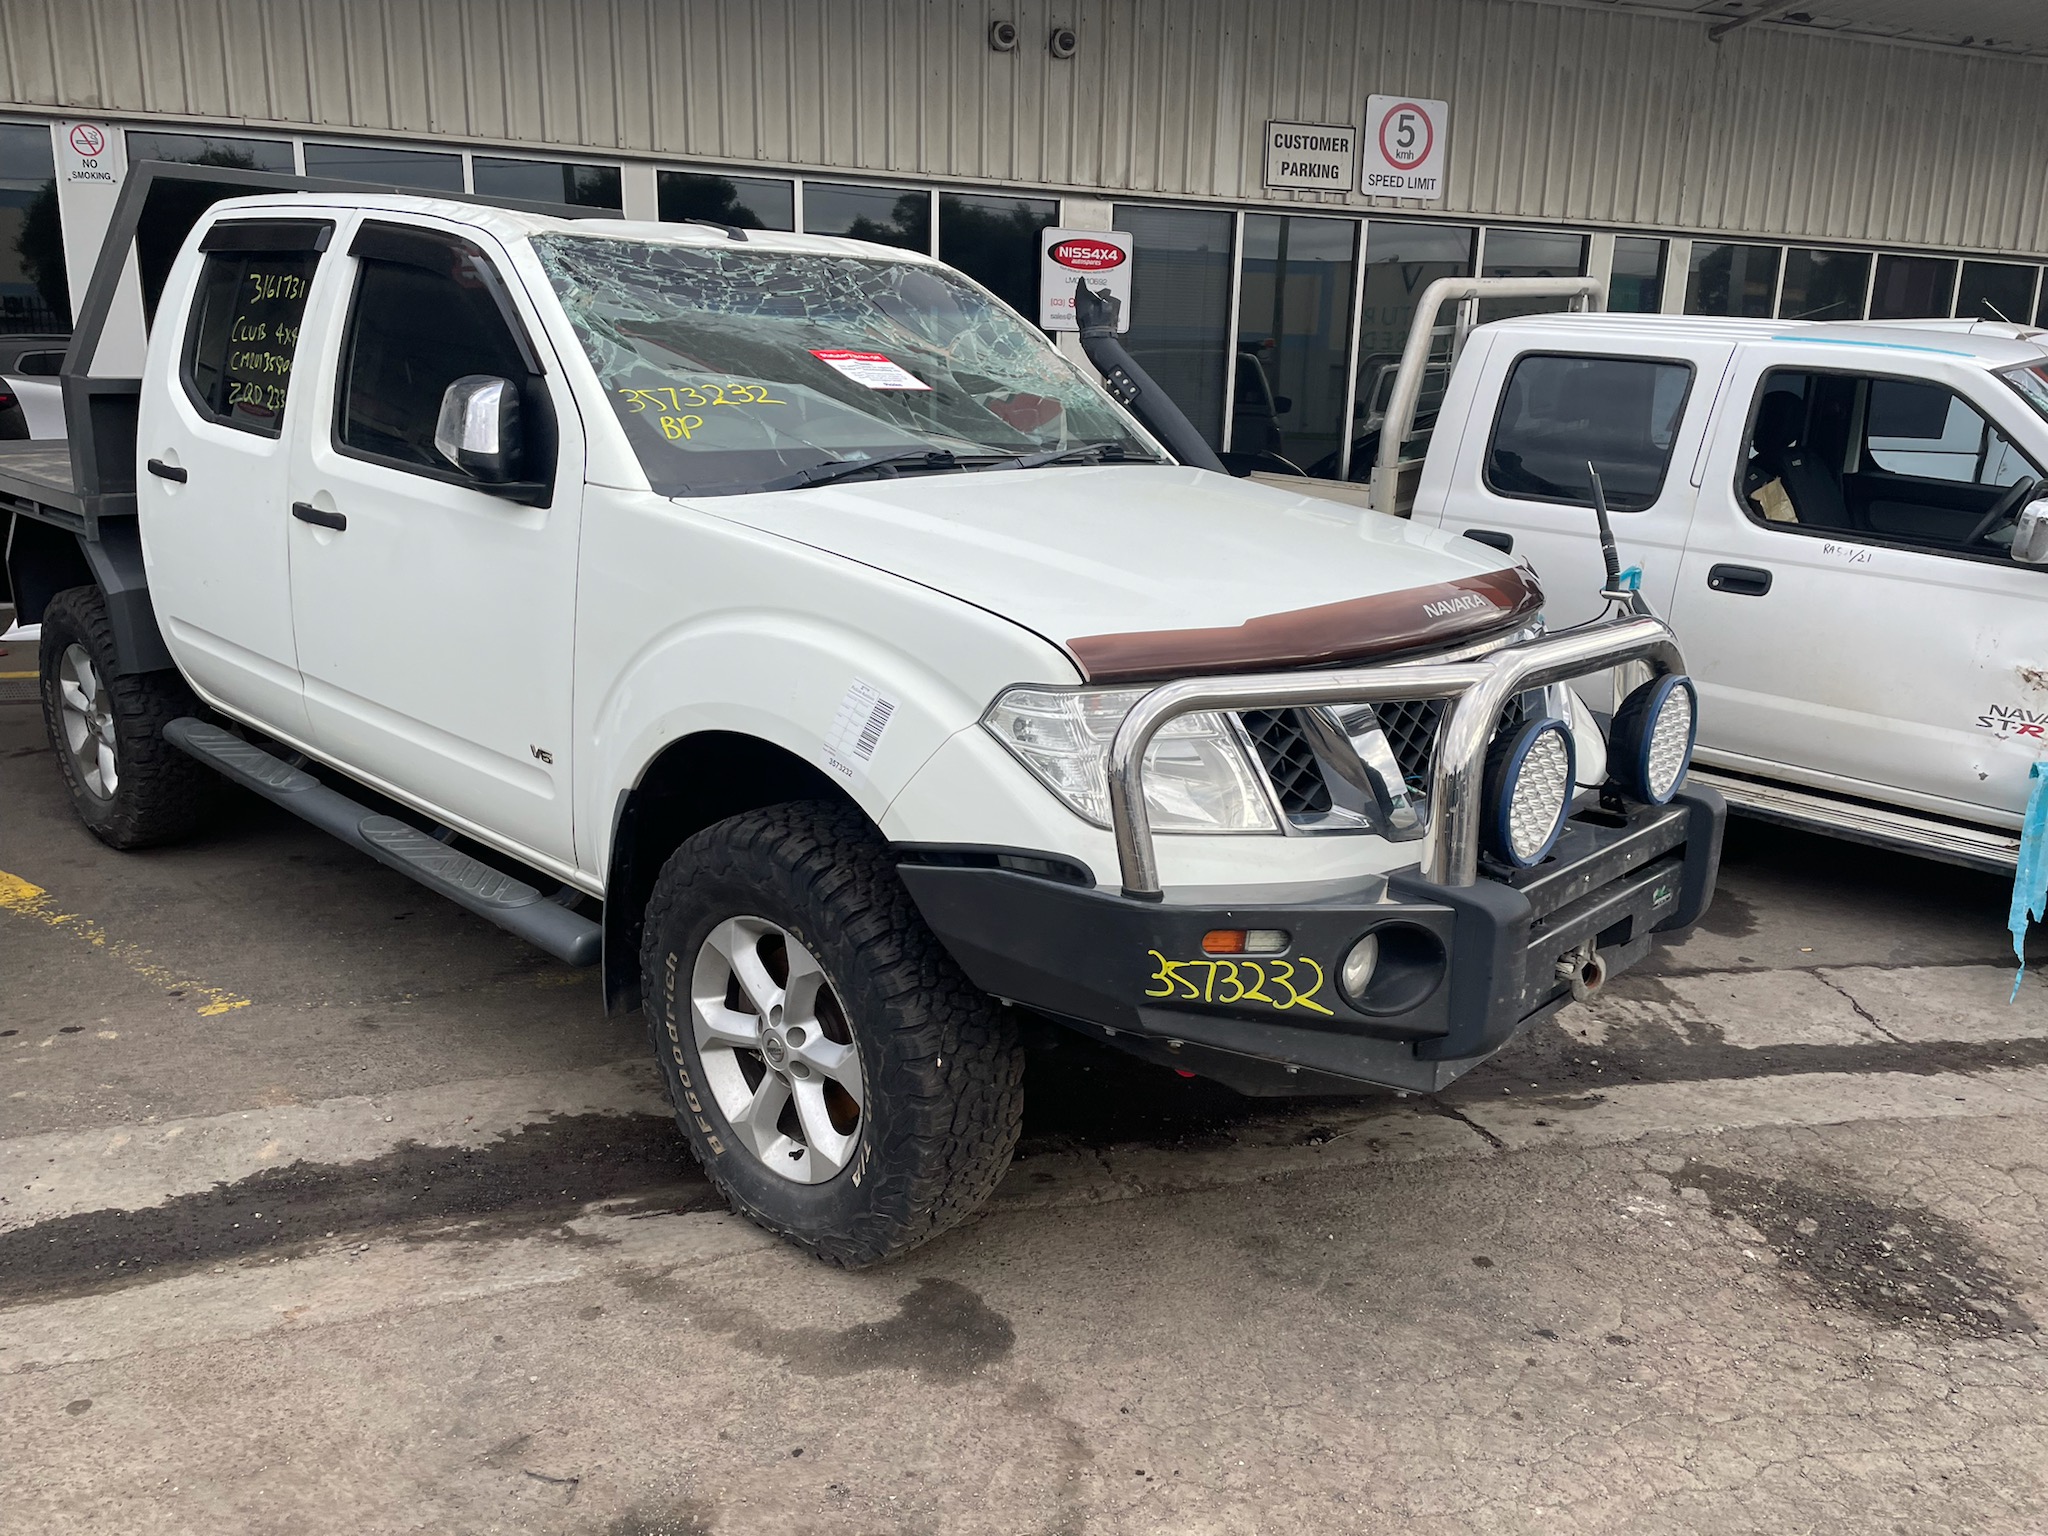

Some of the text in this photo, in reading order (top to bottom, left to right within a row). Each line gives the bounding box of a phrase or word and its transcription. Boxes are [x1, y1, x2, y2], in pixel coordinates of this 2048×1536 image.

[1396, 114, 1415, 148] 5
[1274, 133, 1349, 153] CUSTOMER
[1395, 148, 1414, 160] kmh
[82, 159, 98, 169] NO
[1281, 161, 1339, 180] PARKING
[72, 170, 111, 181] SMOKING
[1368, 173, 1437, 190] SPEED LIMIT
[1059, 246, 1118, 261] NISS4X4
[250, 273, 306, 304] 3161731
[231, 316, 267, 342] CLUB
[618, 384, 788, 413] 3573232
[659, 415, 703, 440] BP
[1423, 594, 1487, 618] NAVARA
[1976, 715, 2045, 739] ST-R
[530, 744, 553, 765] V6
[828, 757, 854, 777] 3573232
[1145, 949, 1335, 1016] 3573232
[665, 951, 726, 1155] BFGoodrich
